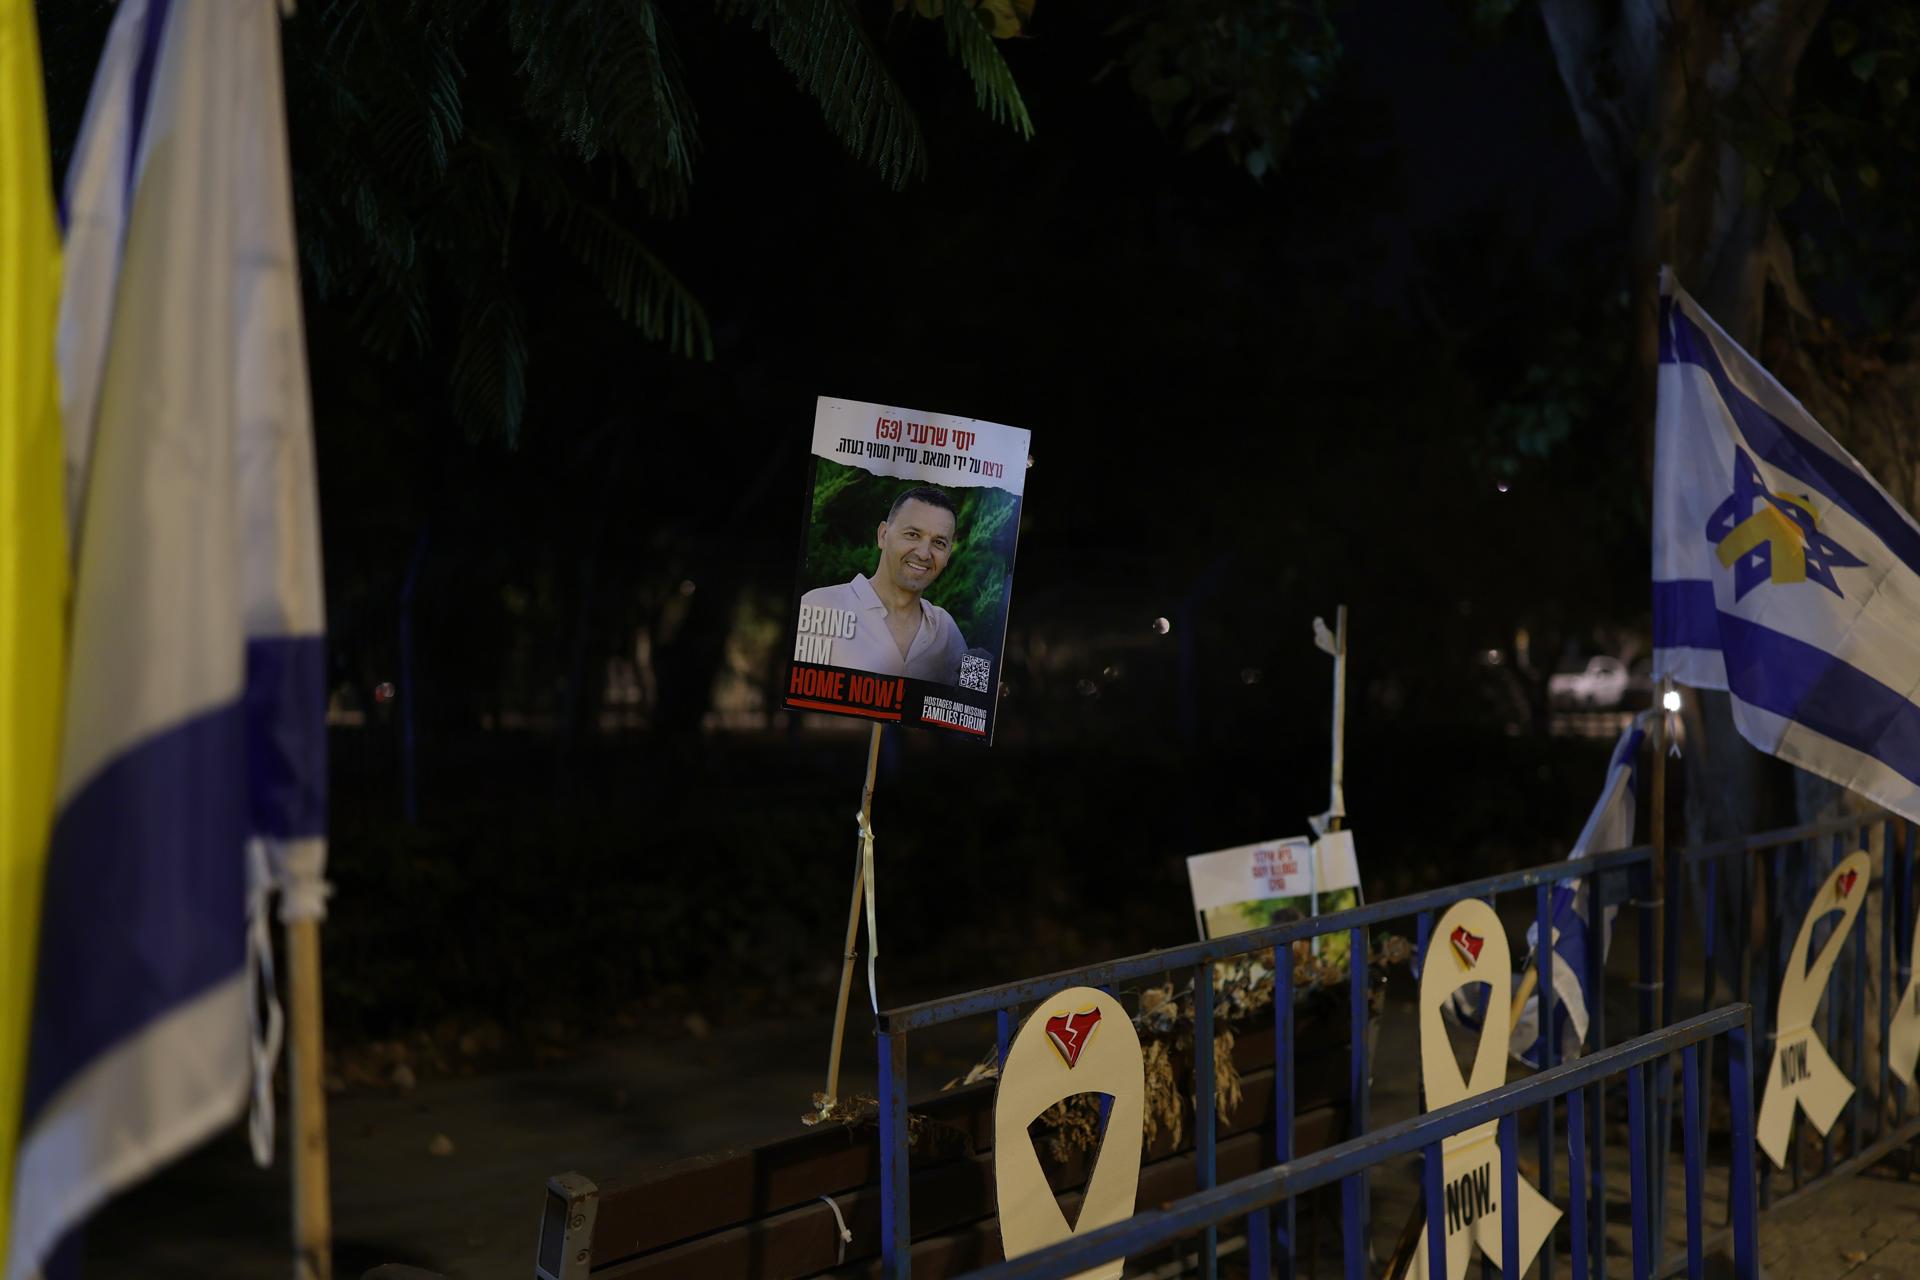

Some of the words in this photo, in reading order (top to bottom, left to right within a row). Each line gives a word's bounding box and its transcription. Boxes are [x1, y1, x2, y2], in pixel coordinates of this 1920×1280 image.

[875, 416, 903, 443] (53)
[907, 422, 949, 447] שרעבי
[952, 429, 976, 451] יוסי
[835, 437, 864, 456] בעזה.
[866, 441, 890, 459] חטוף
[892, 446, 918, 463] עדיין
[918, 450, 951, 469] חמאס.
[953, 455, 967, 471] ידי
[969, 456, 981, 474] על
[982, 460, 1004, 479] נרצח
[798, 605, 857, 640] BRING
[793, 633, 833, 666] HIM
[789, 666, 846, 701] HOME
[848, 674, 905, 710] NOW!
[921, 704, 958, 725] FAMILIES
[958, 712, 986, 732] FORUM
[923, 696, 953, 710] HOSTAGES
[952, 701, 964, 713] AND
[963, 704, 987, 719] MISSING
[1780, 1038, 1811, 1089] NOW.
[1445, 1162, 1496, 1236] NOW.
